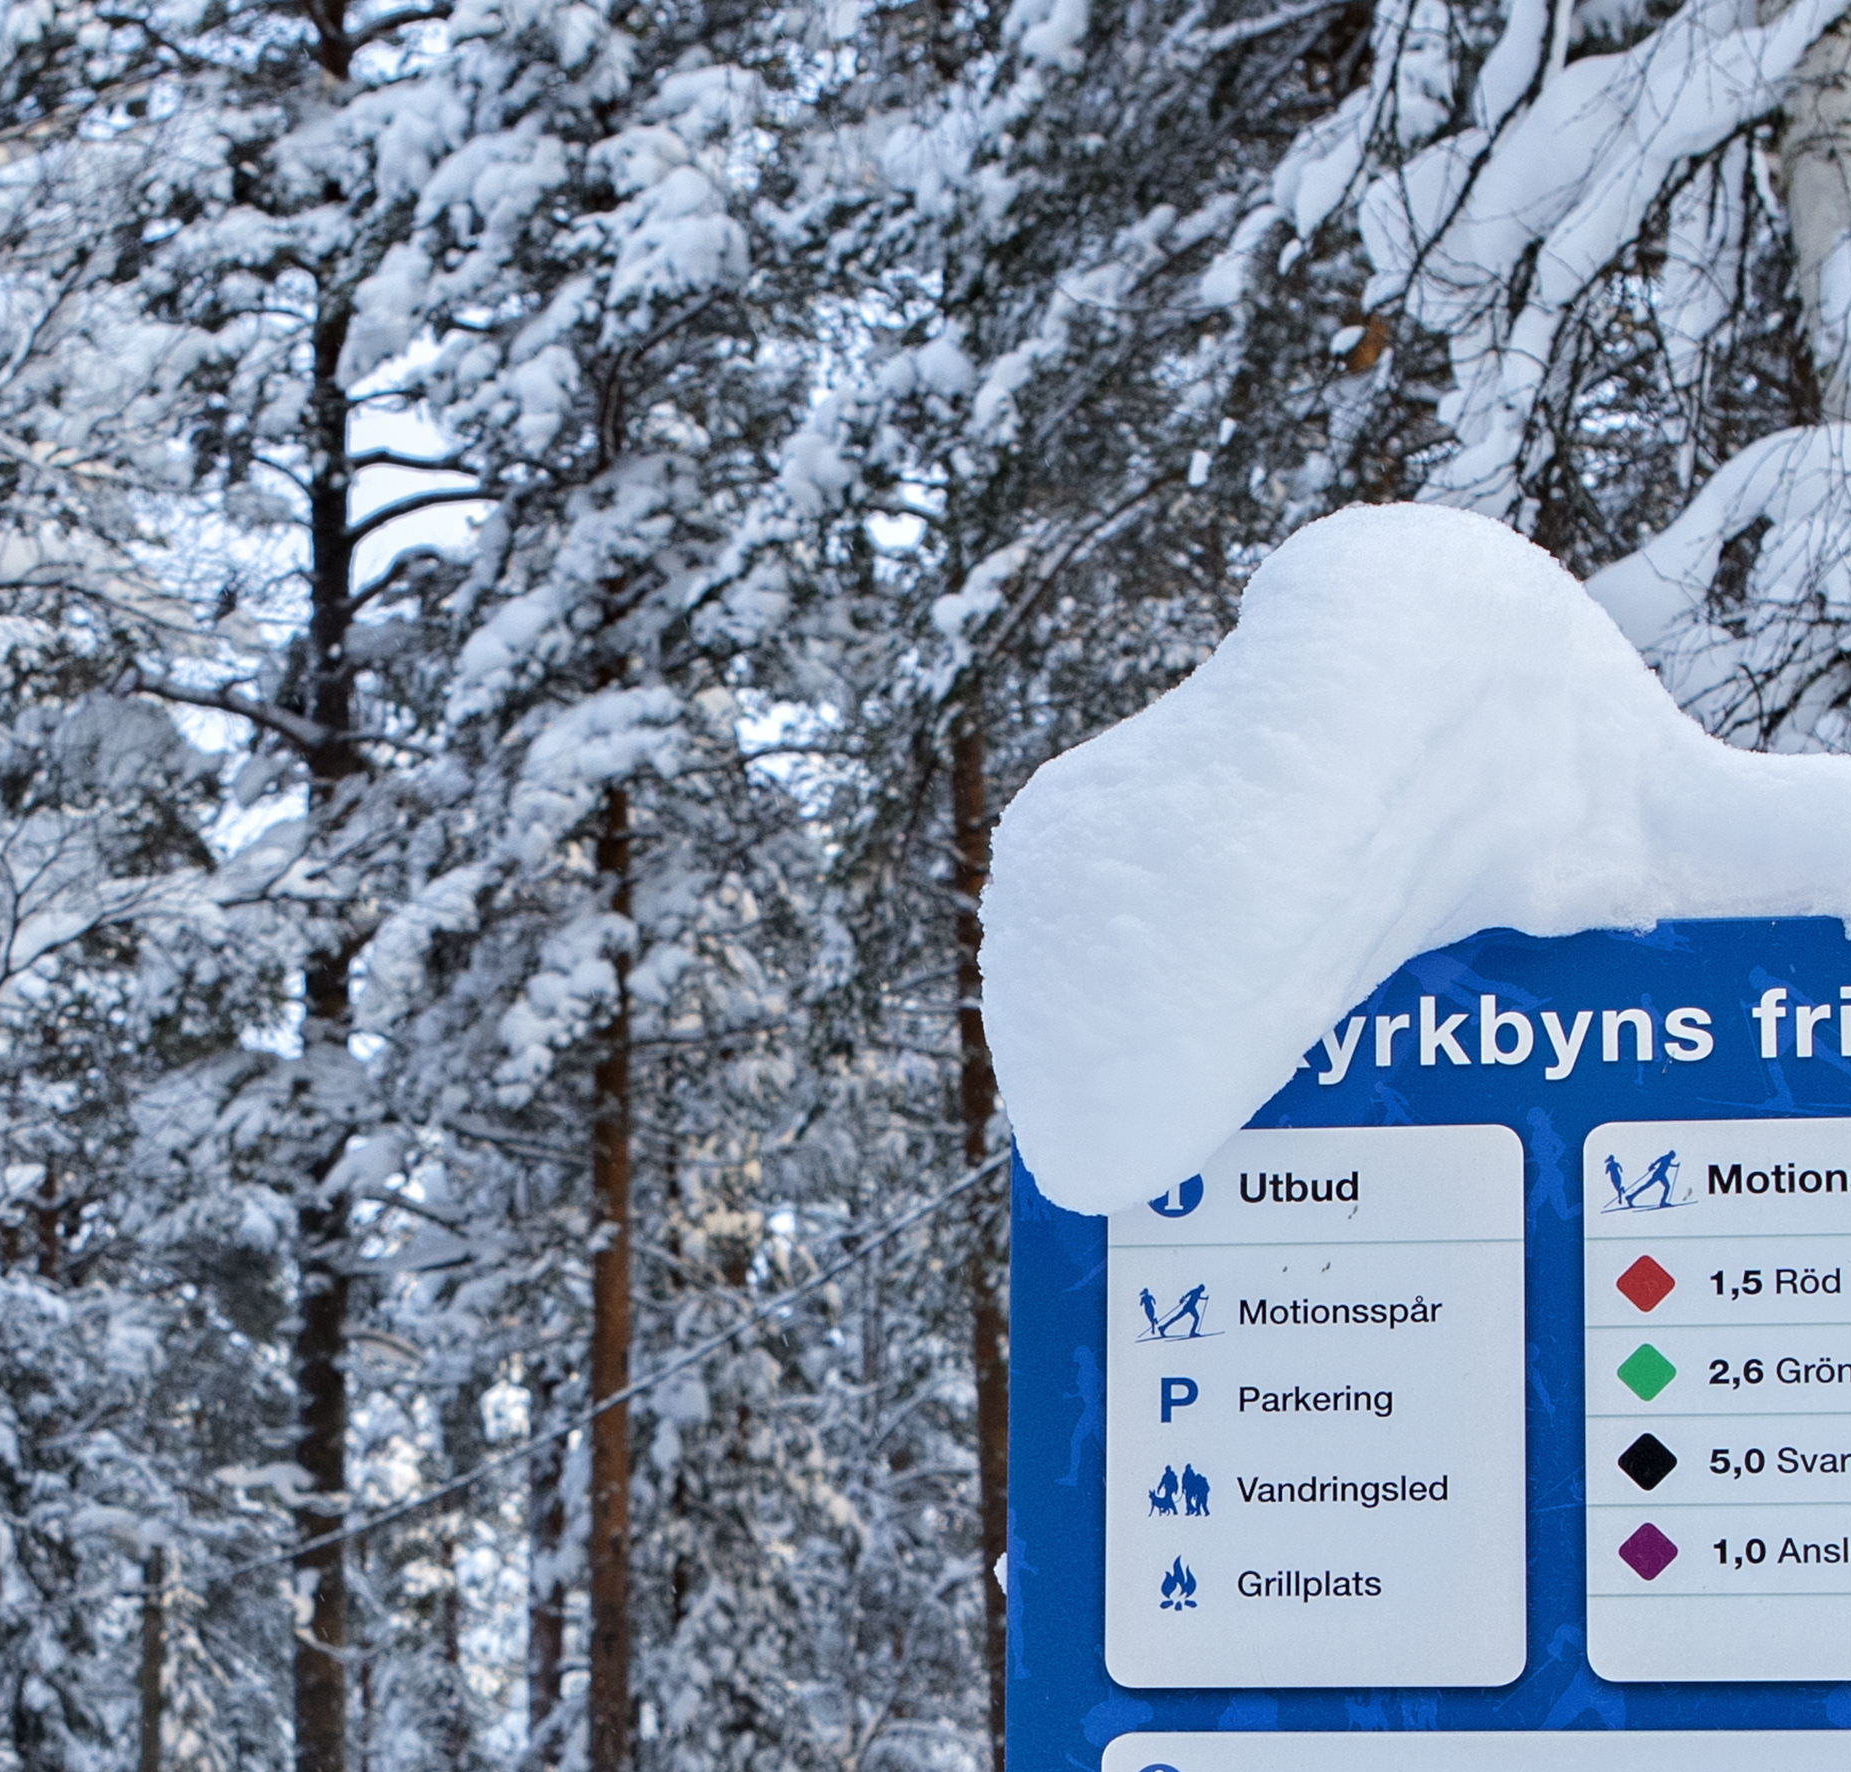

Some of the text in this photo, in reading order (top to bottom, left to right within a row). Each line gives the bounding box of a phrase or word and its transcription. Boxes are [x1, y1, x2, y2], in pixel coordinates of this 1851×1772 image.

[1297, 993, 1714, 1086] yrkbyns
[1240, 1170, 1359, 1204] Utbud
[1710, 1267, 1841, 1301] 1,5 Röd
[1239, 1295, 1443, 1330] Motionsspår
[1709, 1358, 1764, 1390] 2,6
[1160, 1376, 1199, 1424] P
[1239, 1384, 1393, 1418] Parkering
[1709, 1447, 1766, 1480] 5,0
[1236, 1474, 1448, 1509] Vandringsled
[1713, 1538, 1767, 1570] 1,0
[1237, 1570, 1382, 1603] Grillplats
